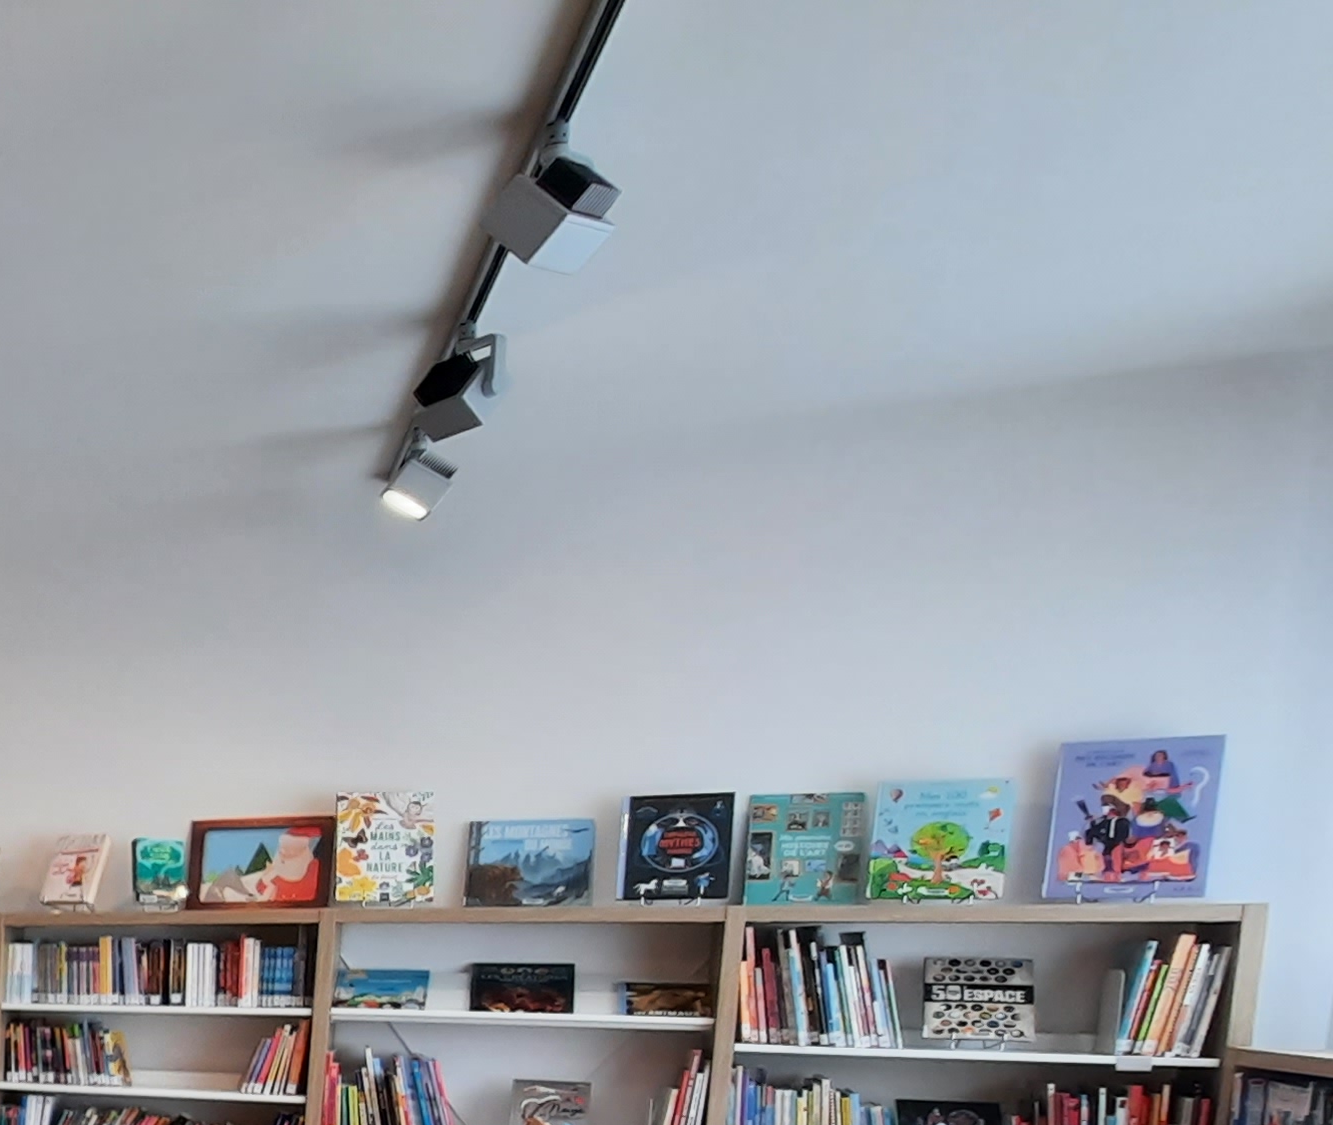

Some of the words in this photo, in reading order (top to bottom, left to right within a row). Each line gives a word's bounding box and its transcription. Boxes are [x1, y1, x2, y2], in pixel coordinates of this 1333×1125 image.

[370, 832, 401, 841] MAINS
[379, 851, 391, 861] LA
[366, 863, 403, 873] NATURE
